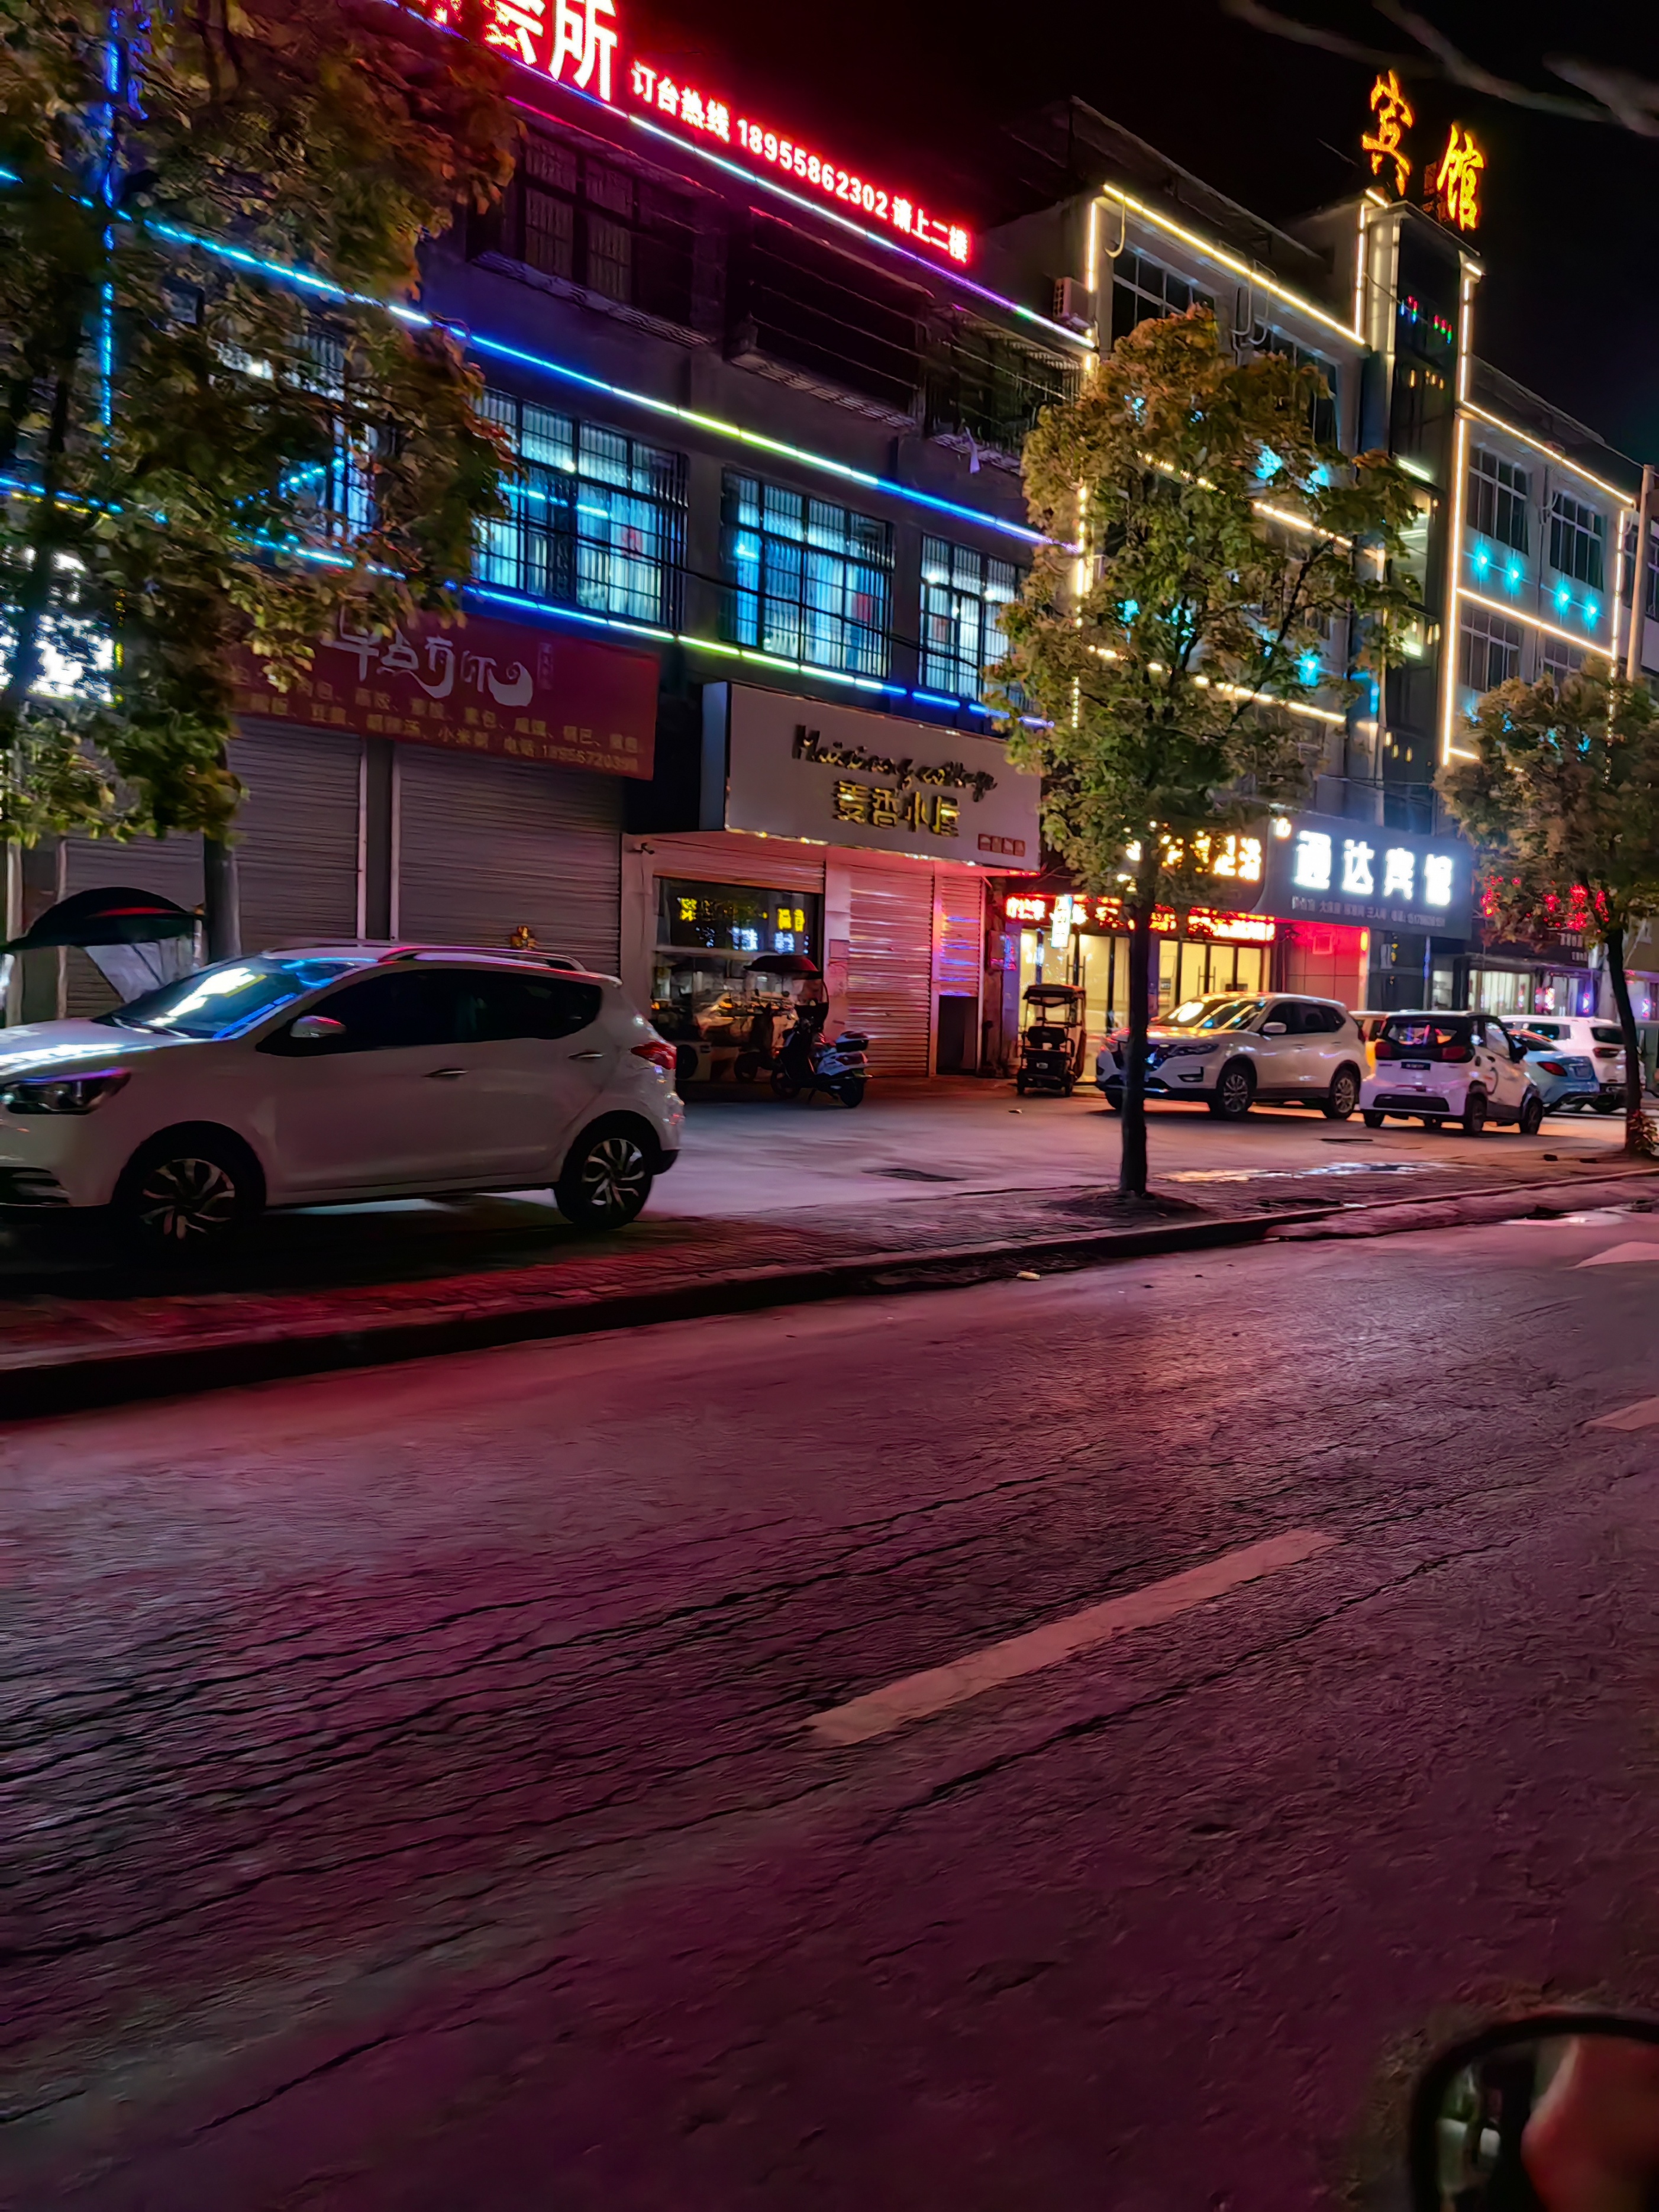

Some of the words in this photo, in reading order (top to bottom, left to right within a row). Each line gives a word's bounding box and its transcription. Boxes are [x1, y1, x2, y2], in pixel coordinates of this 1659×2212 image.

[631, 61, 730, 142] 订台热线
[737, 119, 888, 218] 18955862302
[831, 780, 960, 837] 麦香小屋
[1294, 830, 1453, 906] 通达宾馆
